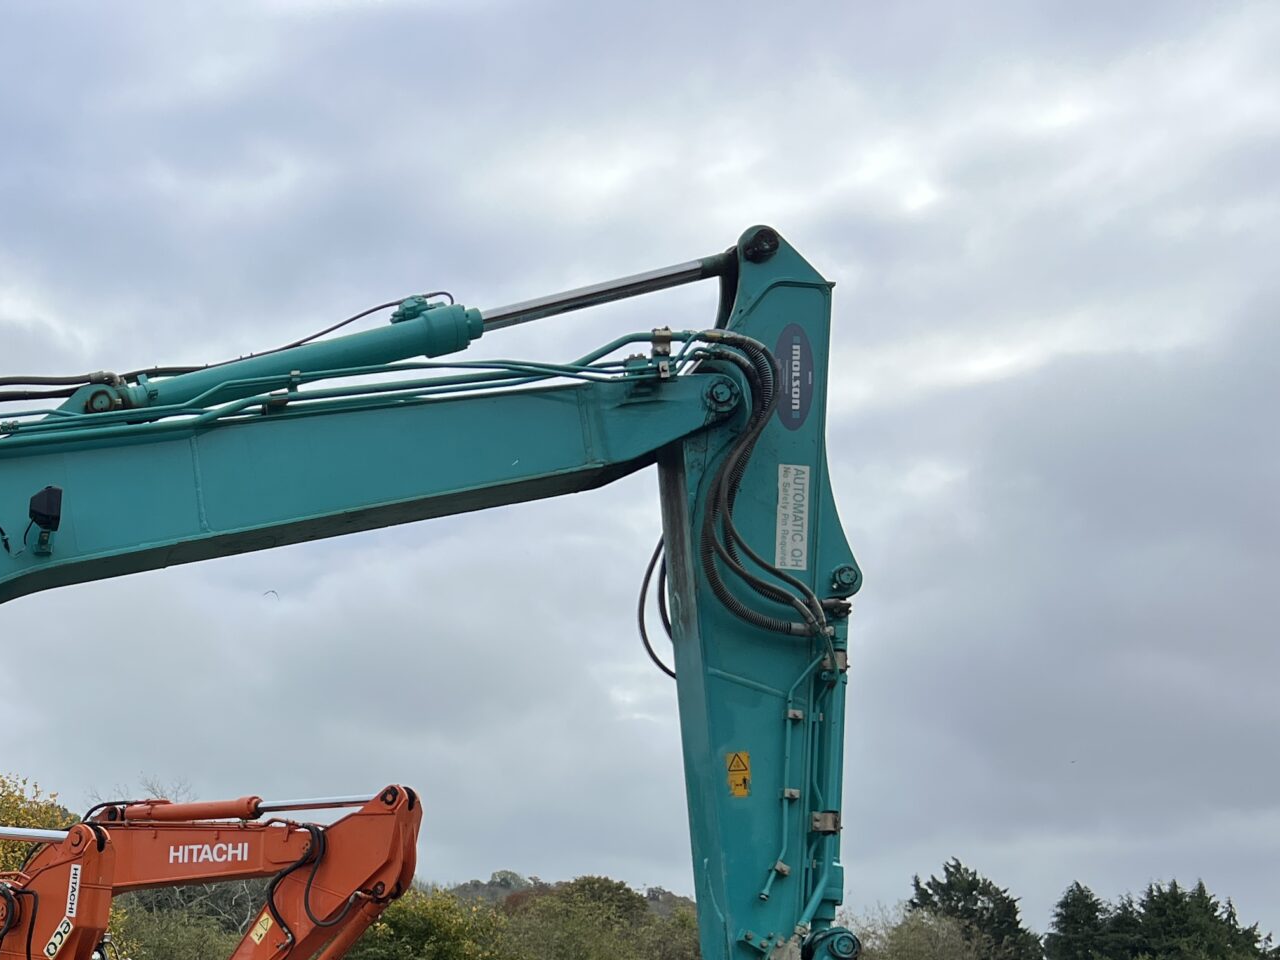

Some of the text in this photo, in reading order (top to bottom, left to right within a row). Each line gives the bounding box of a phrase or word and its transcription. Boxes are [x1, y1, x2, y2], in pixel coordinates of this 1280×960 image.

[779, 466, 791, 567] No Safety Pin Required
[791, 468, 806, 568] AUTOMATIC QH
[168, 842, 249, 864] HITACHI
[68, 867, 79, 914] HITACHI
